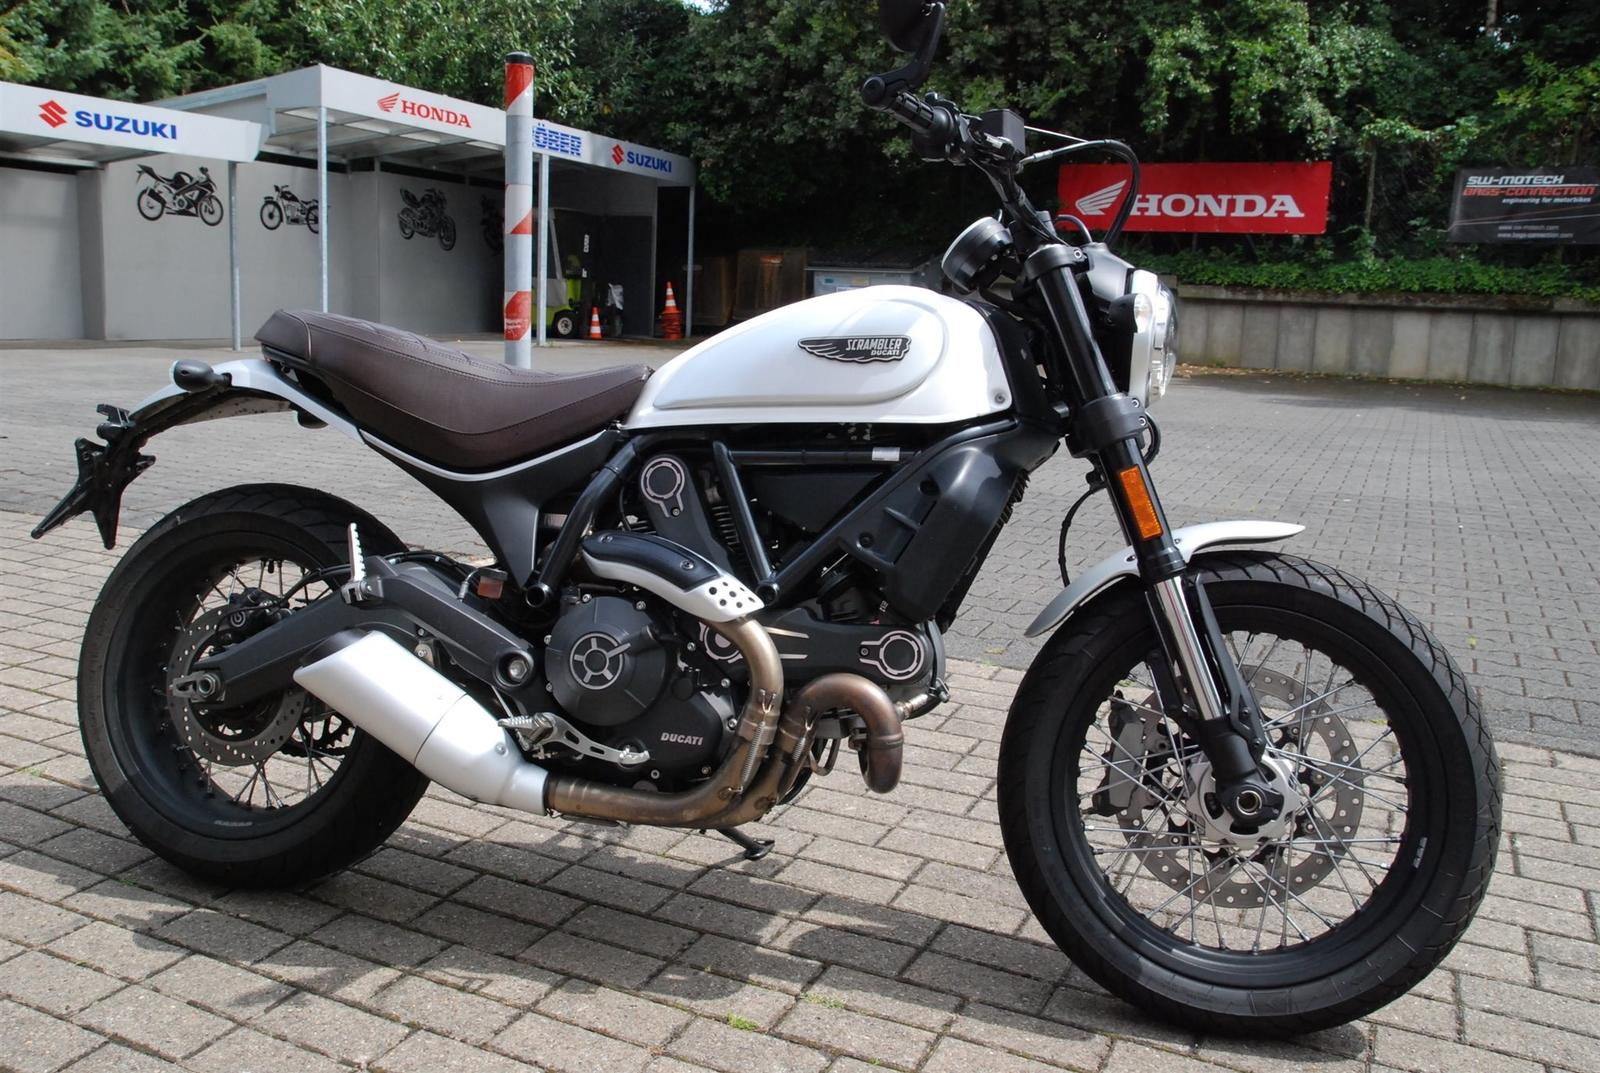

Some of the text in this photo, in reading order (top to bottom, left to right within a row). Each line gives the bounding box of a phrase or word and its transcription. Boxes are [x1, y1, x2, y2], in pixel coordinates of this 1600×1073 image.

[75, 110, 177, 140] SUZUKI
[401, 99, 471, 128] HONDA
[627, 150, 672, 173] SUZUKI
[1467, 175, 1565, 185] SW-MOTECH
[1129, 194, 1304, 218] HONDA
[845, 338, 902, 351] SCRAMBLER
[660, 732, 704, 746] DUCATI
